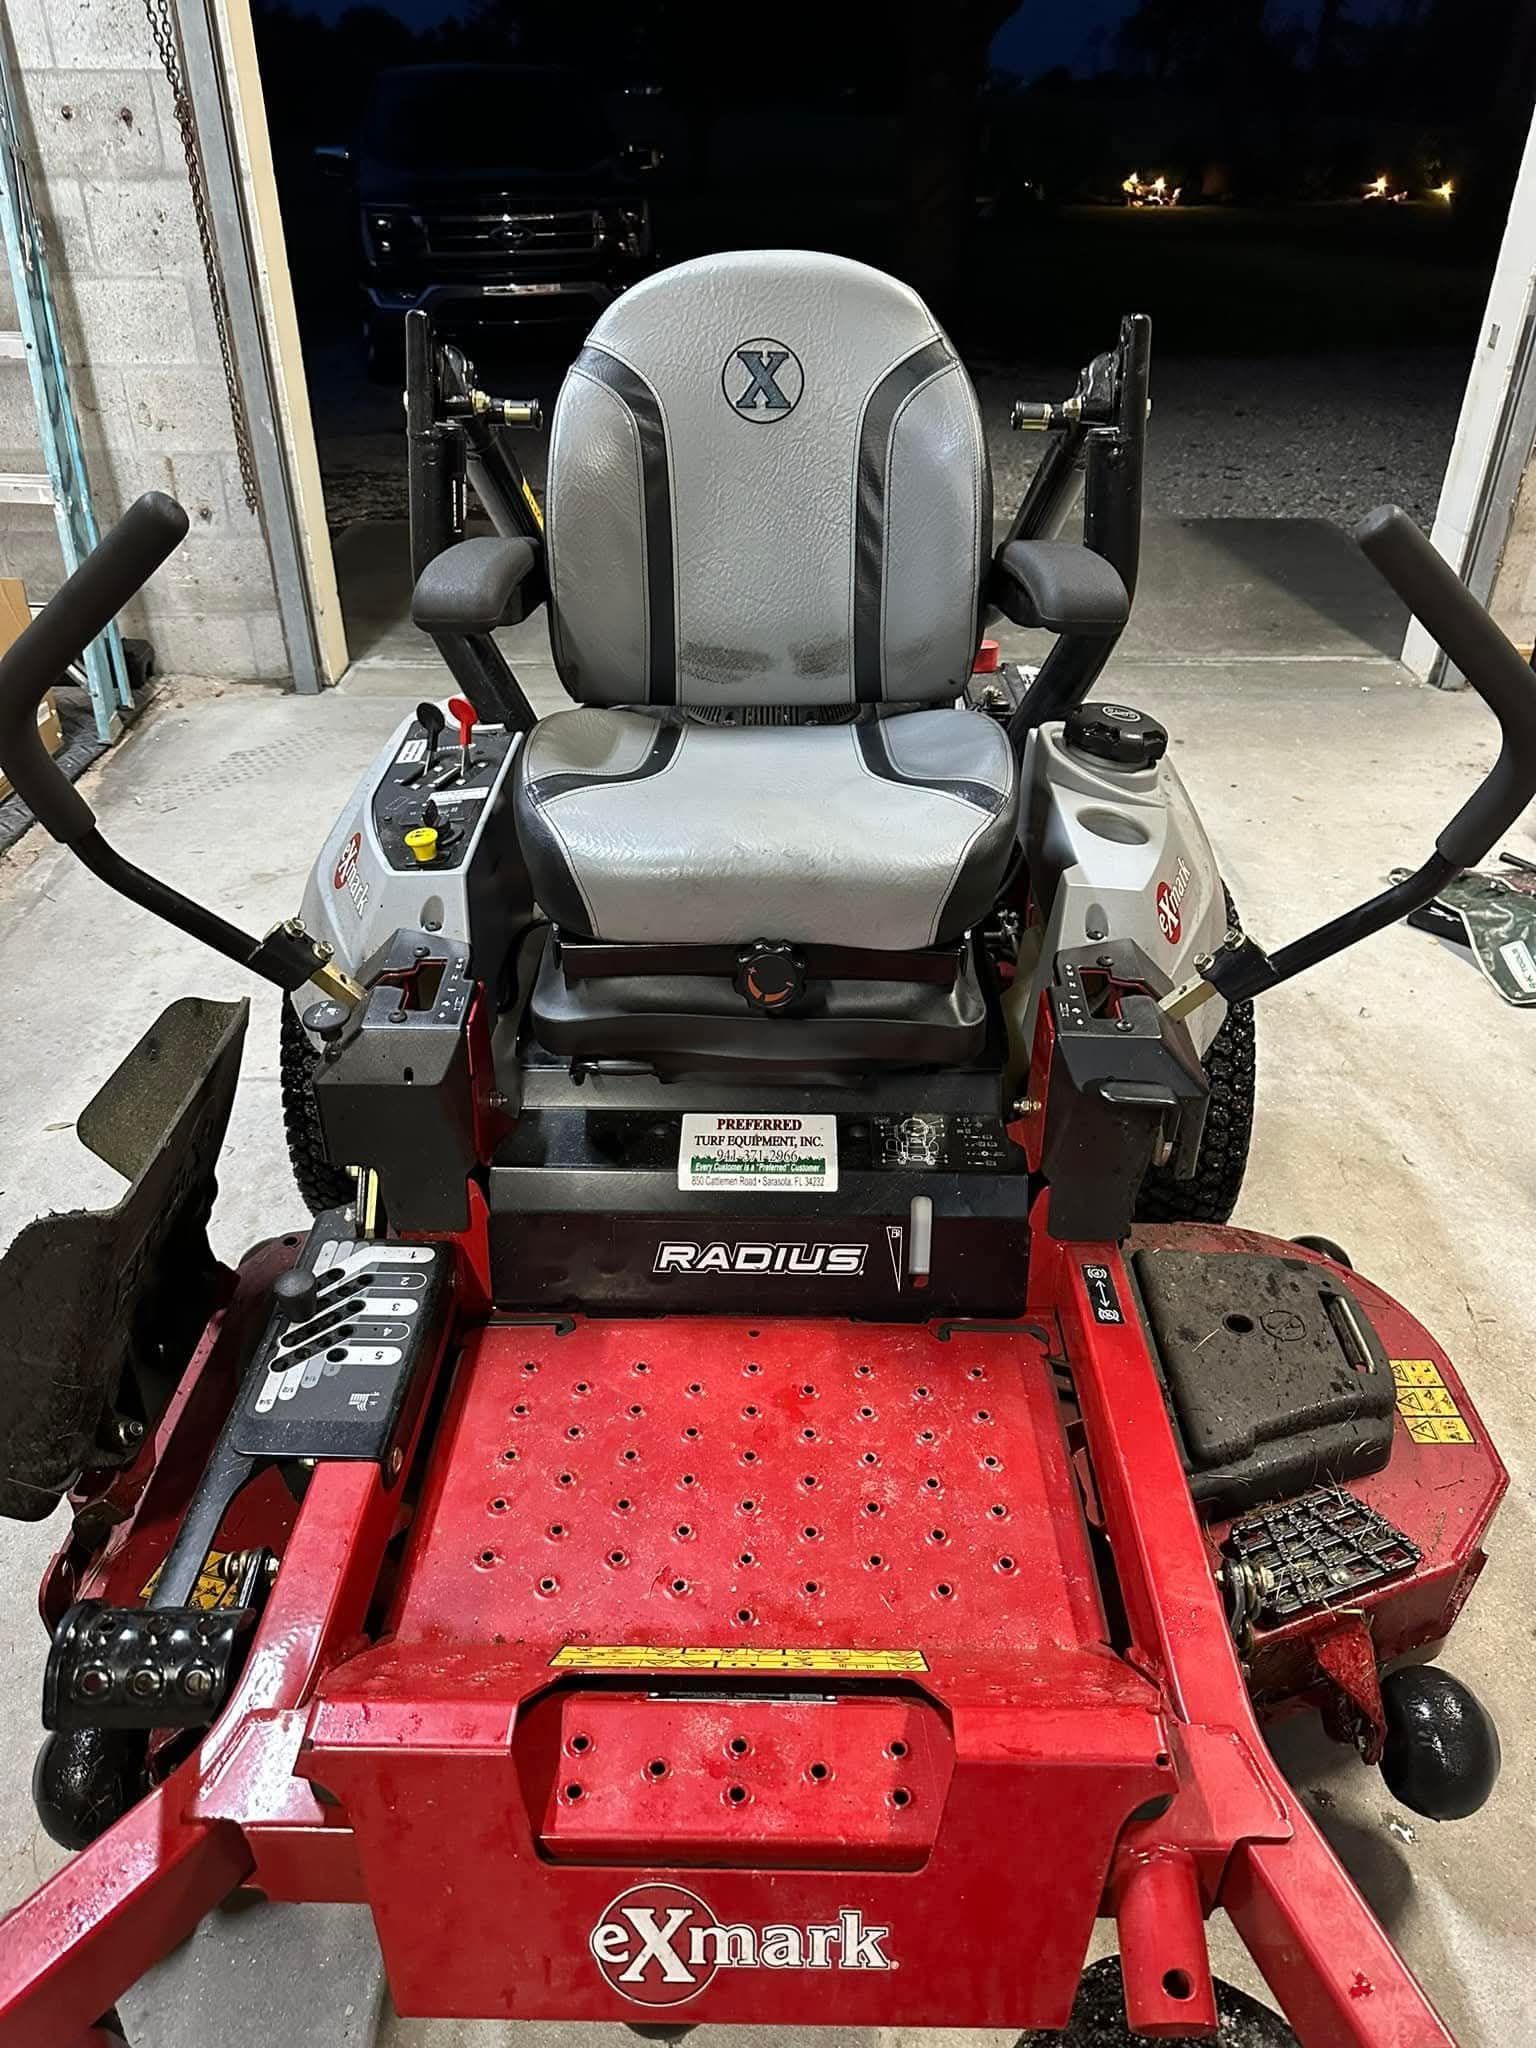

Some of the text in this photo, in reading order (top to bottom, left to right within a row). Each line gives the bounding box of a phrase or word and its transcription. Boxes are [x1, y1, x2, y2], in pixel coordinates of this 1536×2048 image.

[1158, 855, 1192, 940] eXmark
[717, 1118, 803, 1131] PREFERRED
[694, 1135, 824, 1149] TURF EQUIPMENT, INC.
[716, 1149, 799, 1163] 941-371-2966
[695, 1162, 713, 1174] Every
[714, 1162, 743, 1173] Customer
[790, 1163, 820, 1174] Customer
[739, 1176, 757, 1187] Road
[409, 1250, 417, 1260] 1
[653, 1241, 869, 1276] RADIUS
[400, 1276, 411, 1286] 2
[391, 1303, 401, 1312] 3
[383, 1327, 393, 1337] 4
[375, 1351, 384, 1360] 5
[590, 1906, 890, 1985] eXmark
